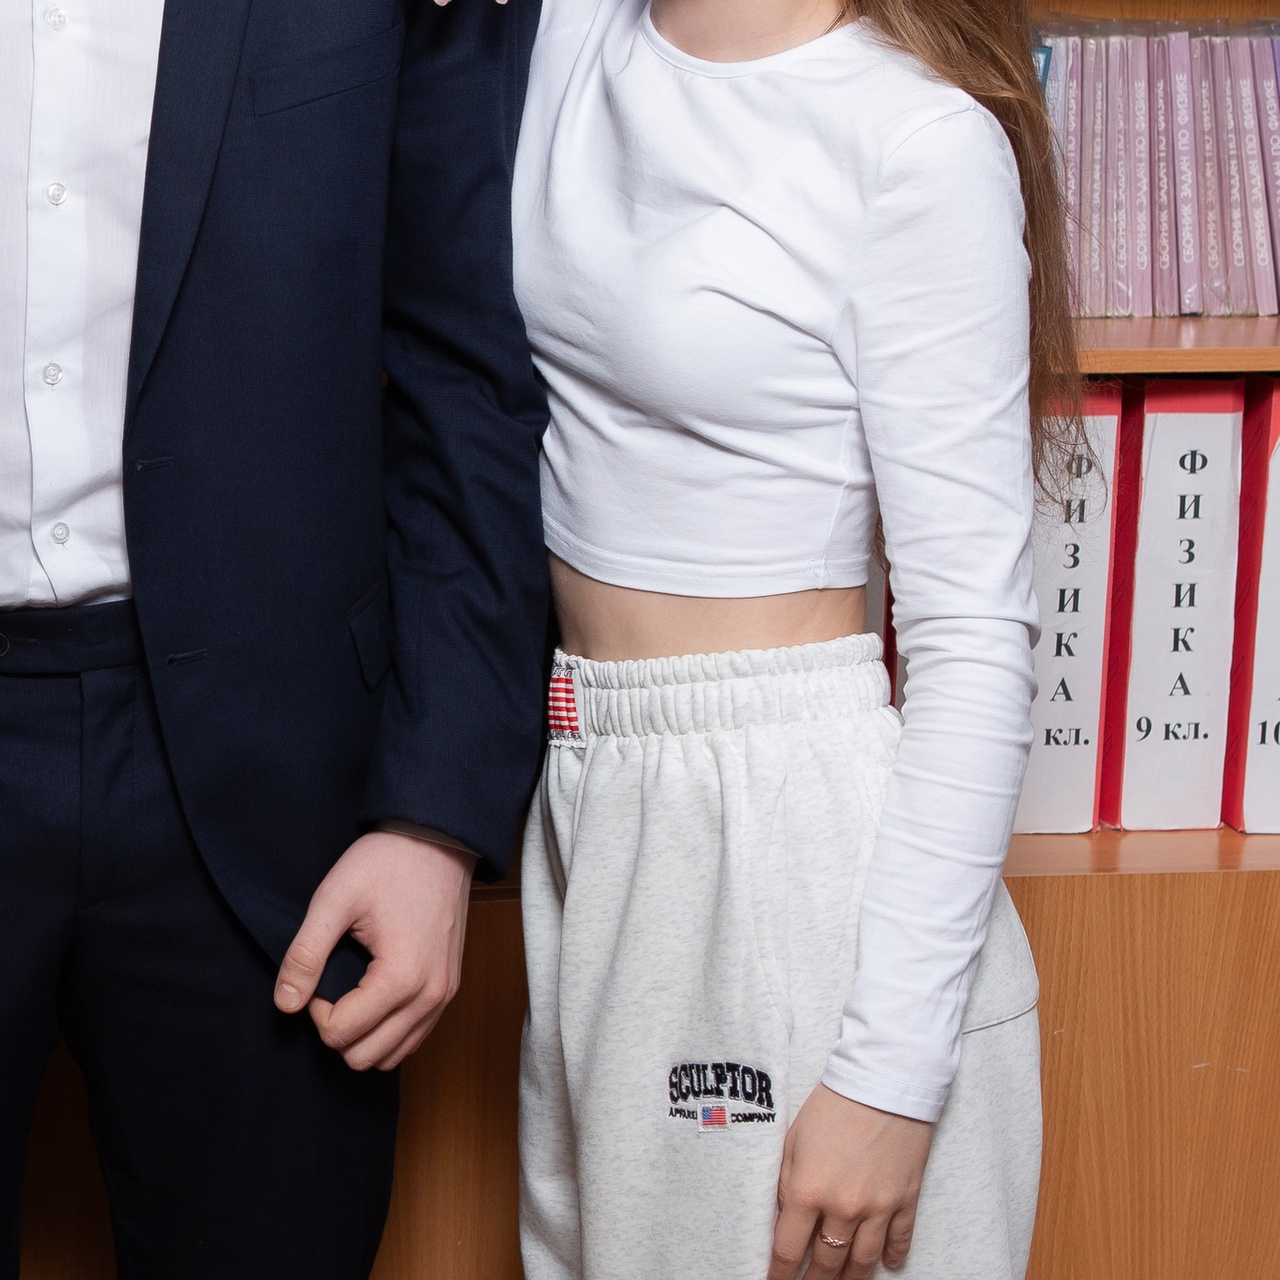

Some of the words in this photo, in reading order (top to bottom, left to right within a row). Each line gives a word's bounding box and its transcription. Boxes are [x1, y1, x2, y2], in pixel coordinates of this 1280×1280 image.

[1135, 80, 1146, 131] ФИЗИКЕ
[1176, 73, 1188, 125] ФИЗИКЕ
[1240, 78, 1254, 130] ФИЗИКЕ
[1264, 78, 1279, 131] ФИЗИКЕ
[1136, 137, 1146, 157] ПО
[1158, 136, 1166, 156] ПО
[1178, 129, 1189, 150] ПО
[1227, 134, 1236, 155] ПО
[1245, 134, 1256, 155] ПО
[1270, 135, 1280, 156] ПО
[1136, 163, 1147, 206] ЗАДАЧ
[1158, 162, 1168, 205] ЗАДАЧ
[1180, 156, 1192, 198] ЗАДАЧ
[1229, 160, 1240, 203] ЗАДАЧ
[1248, 159, 1263, 203] ЗАДАЧ
[1136, 210, 1148, 270] СБОРНИК
[1159, 209, 1169, 269] СБОРНИК
[1181, 203, 1194, 263] СБОРНИК
[1208, 210, 1219, 269] СБОРНИК
[1232, 208, 1245, 267] СБОРНИК
[1253, 207, 1269, 266] СБОРНИК
[1050, 453, 1093, 702] ФИЗИКА
[1168, 449, 1208, 697] ФИЗИКА
[1043, 727, 1090, 746] кл.
[1135, 716, 1152, 742] 9
[1163, 722, 1209, 741] кл.
[668, 1062, 774, 1109] SCULPTOR
